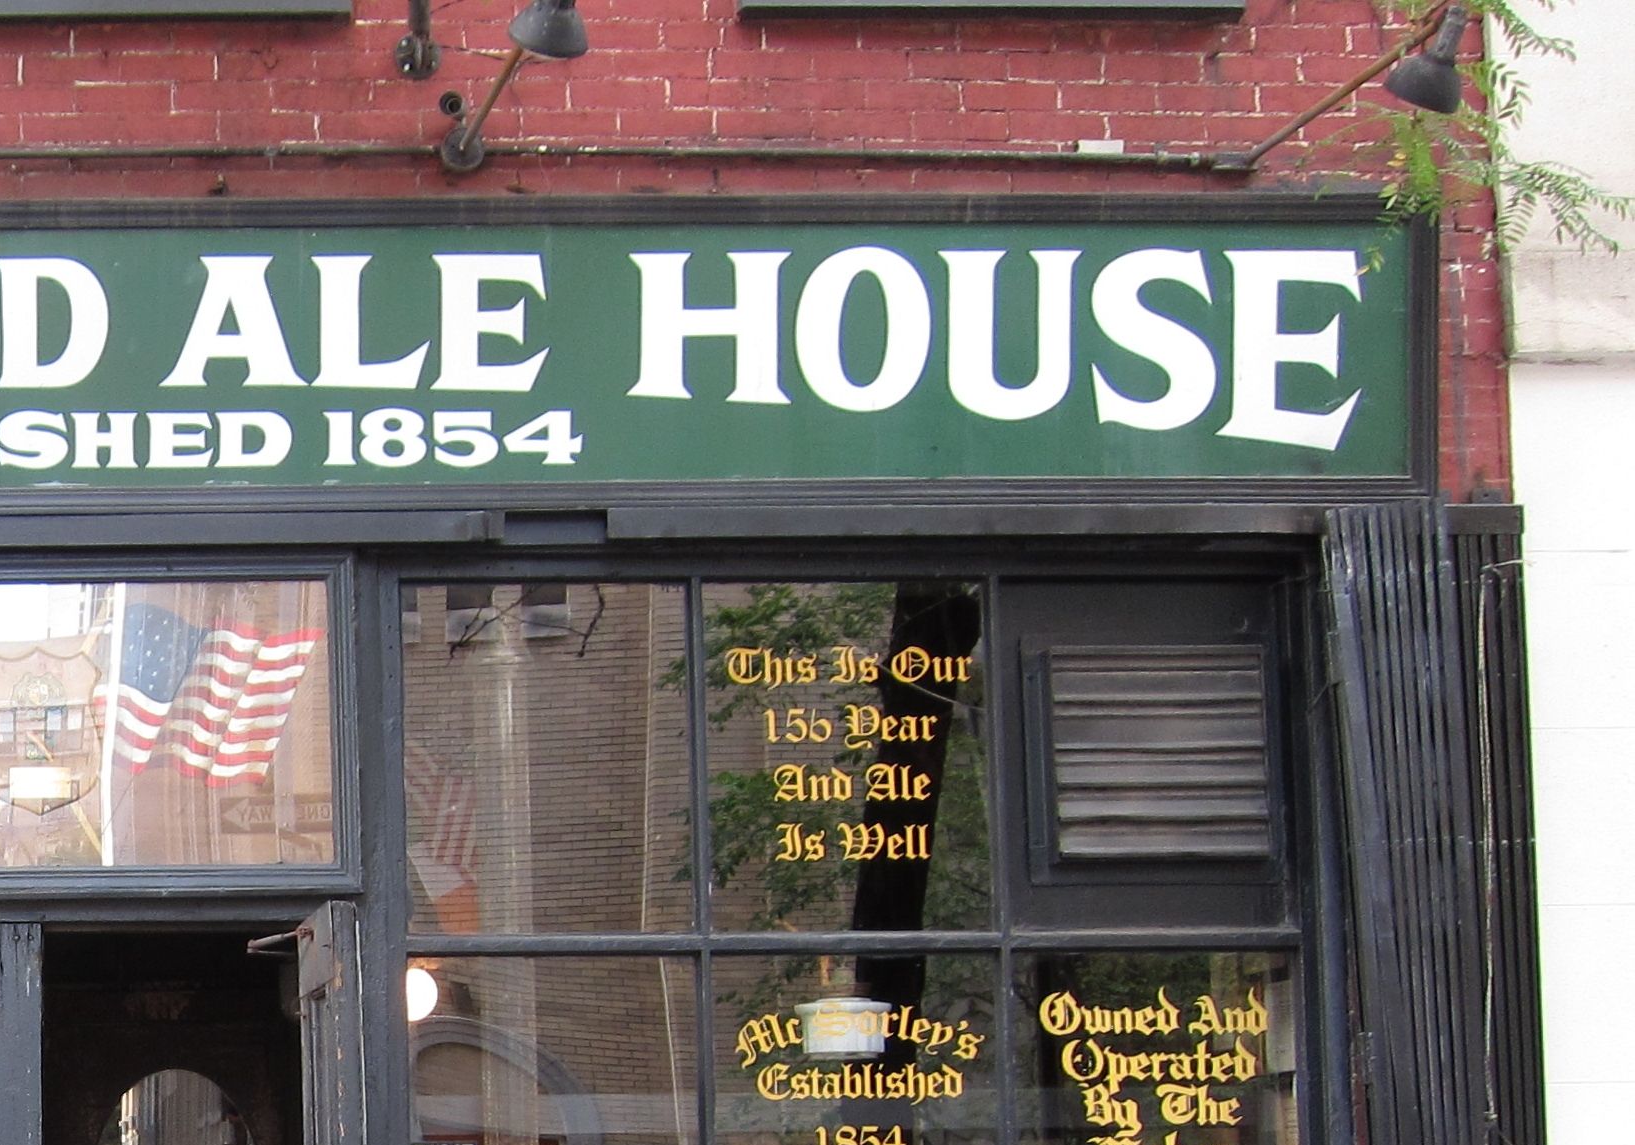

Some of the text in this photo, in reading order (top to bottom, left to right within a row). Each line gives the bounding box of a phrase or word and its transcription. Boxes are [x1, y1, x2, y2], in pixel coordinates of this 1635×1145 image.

[160, 251, 552, 393] ALE
[627, 246, 1363, 451] HOUSE
[323, 409, 583, 468] 1854
[725, 645, 973, 691] This Is Our
[763, 704, 939, 750] 156 Year
[773, 763, 932, 802] And Ale
[775, 822, 931, 862] Is Well
[735, 1001, 985, 1069] Mc Sorley's
[1039, 986, 1269, 1036] Owned And
[757, 1062, 963, 1106] Established
[1062, 1036, 1257, 1095] Operated
[1078, 1083, 1243, 1139] By The
